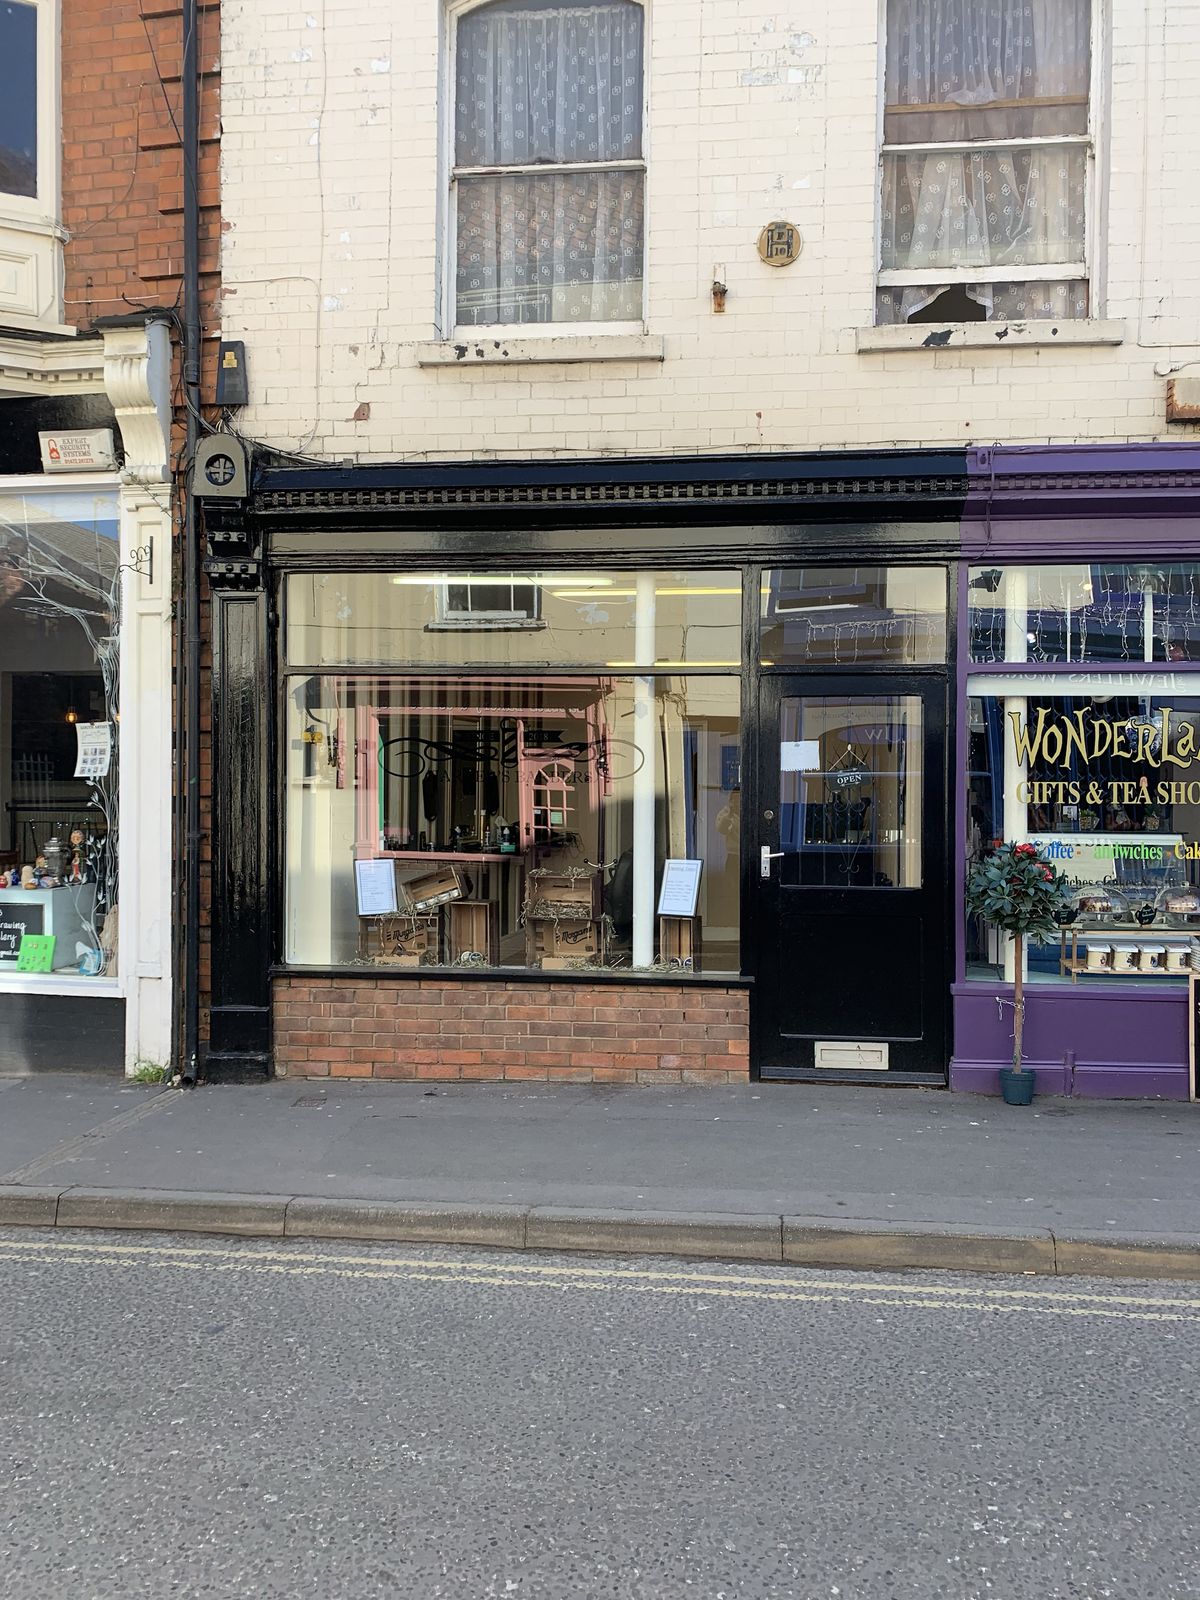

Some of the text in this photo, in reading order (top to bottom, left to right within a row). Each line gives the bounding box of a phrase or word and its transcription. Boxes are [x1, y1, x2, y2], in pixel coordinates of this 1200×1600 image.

[63, 450, 91, 458] SYSTEMS
[837, 774, 862, 785] OPEN
[1016, 781, 1200, 804] GIFTS & TEA SHO
[1094, 843, 1163, 860] andwiches
